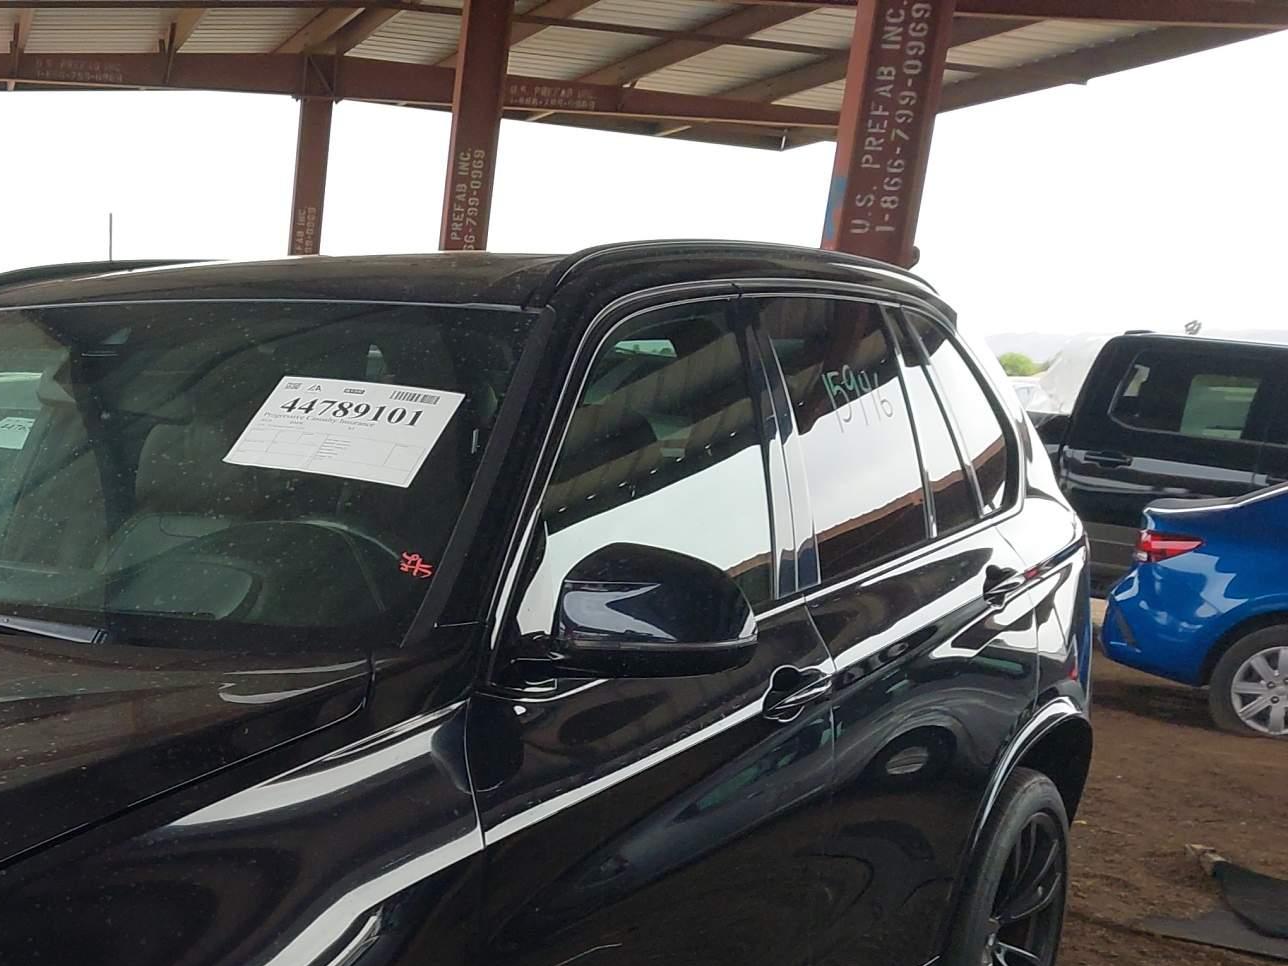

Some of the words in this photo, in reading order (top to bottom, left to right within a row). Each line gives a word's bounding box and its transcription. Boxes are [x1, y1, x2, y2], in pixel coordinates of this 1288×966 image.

[881, 0, 908, 50] INC.
[860, 66, 897, 169] PREFAB
[875, 3, 932, 232] 1-866-799-0969
[457, 147, 472, 176] INC.
[450, 183, 468, 241] PREFAB
[850, 186, 878, 234] U.S.
[280, 397, 424, 427] 44789101
[821, 364, 894, 433] 15946
